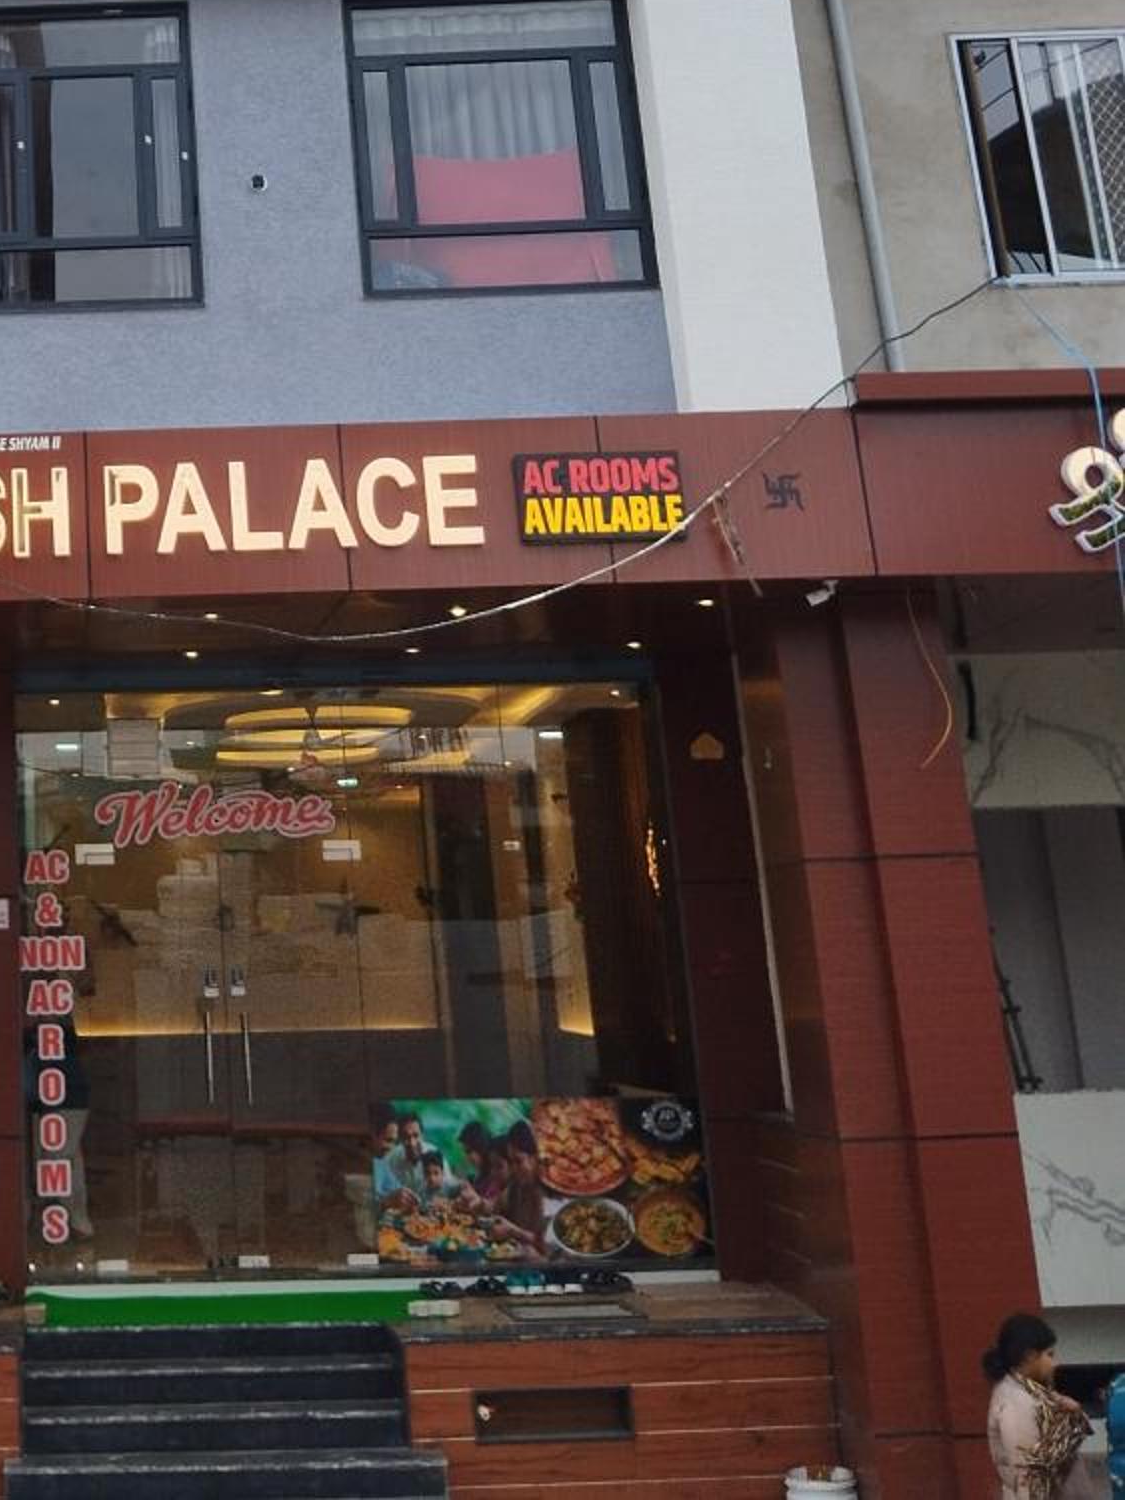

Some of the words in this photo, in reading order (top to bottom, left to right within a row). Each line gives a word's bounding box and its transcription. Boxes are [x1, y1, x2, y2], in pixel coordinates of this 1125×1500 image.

[7, 436, 51, 451] SHYAM
[524, 460, 562, 494] AC
[569, 457, 679, 492] ROOMS
[104, 455, 485, 555] PALACE
[524, 494, 684, 534] AVAILABLE
[95, 780, 335, 848] Welcome
[25, 850, 69, 884] AC
[35, 894, 62, 927] &
[20, 936, 85, 971] NON
[26, 980, 73, 1015] AC
[37, 1023, 70, 1244] ROOMS
